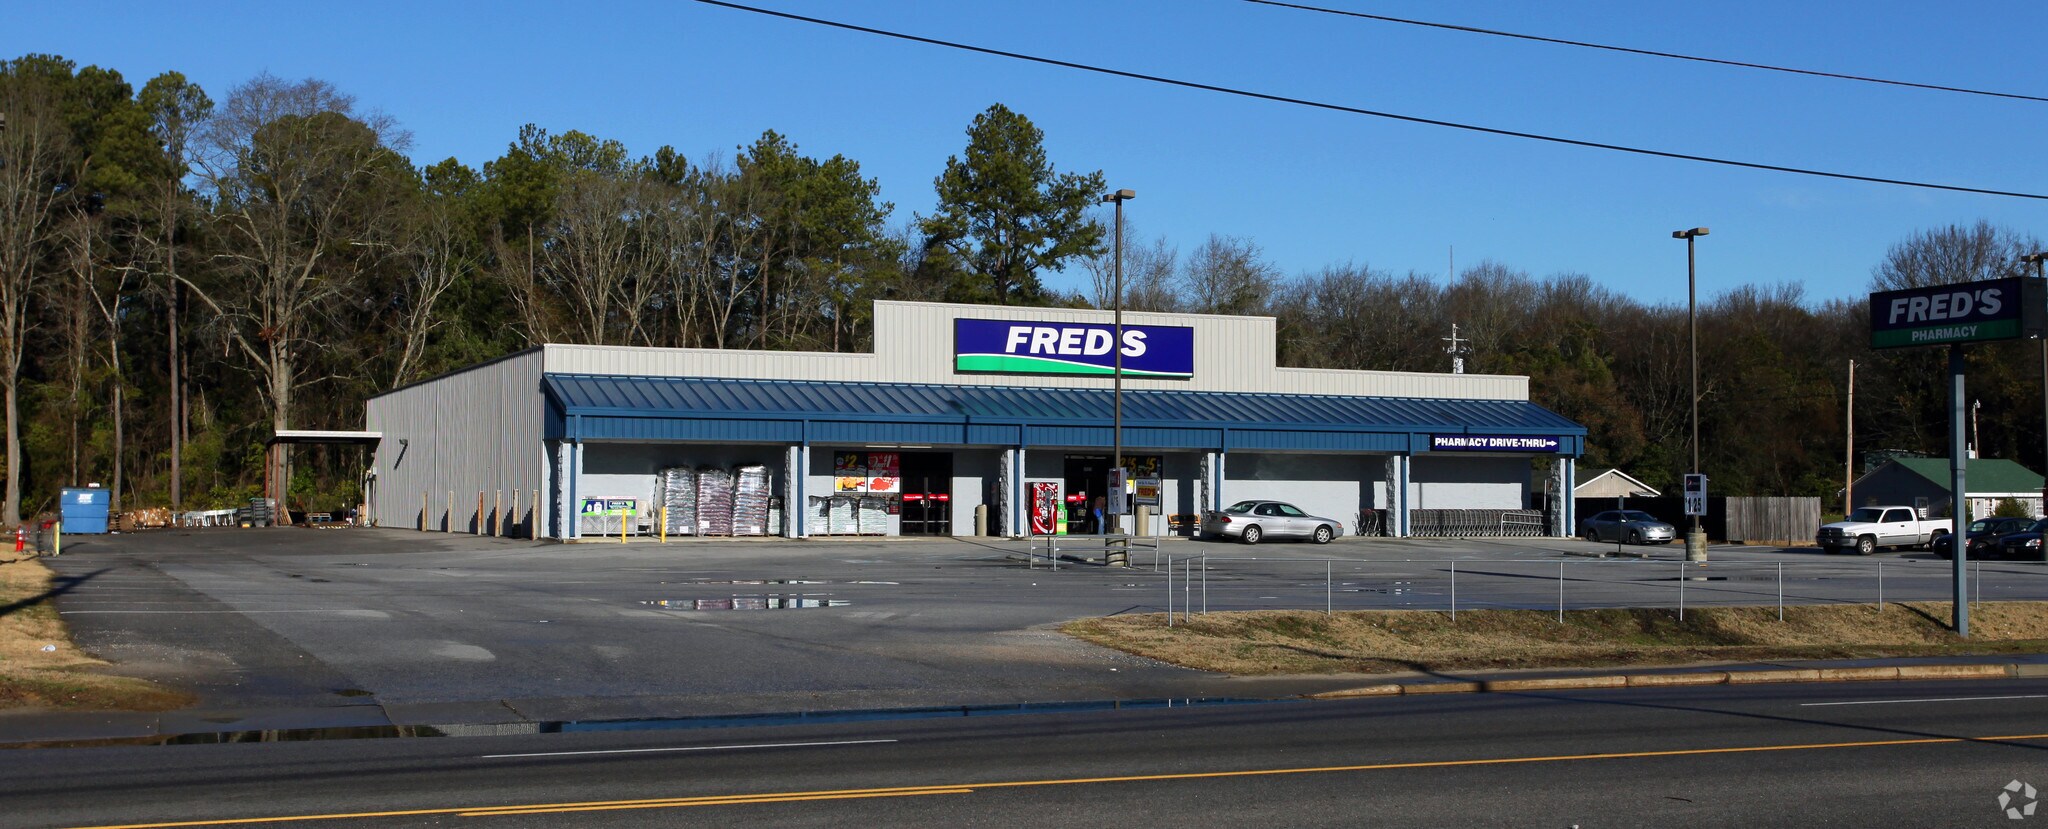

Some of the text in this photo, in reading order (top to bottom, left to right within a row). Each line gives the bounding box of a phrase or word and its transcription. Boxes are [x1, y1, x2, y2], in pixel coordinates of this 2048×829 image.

[1889, 288, 2002, 324] FRED'S
[1911, 325, 1978, 341] PHARMACY
[1435, 437, 1547, 448] PHARMACY DRIVE-THRU
